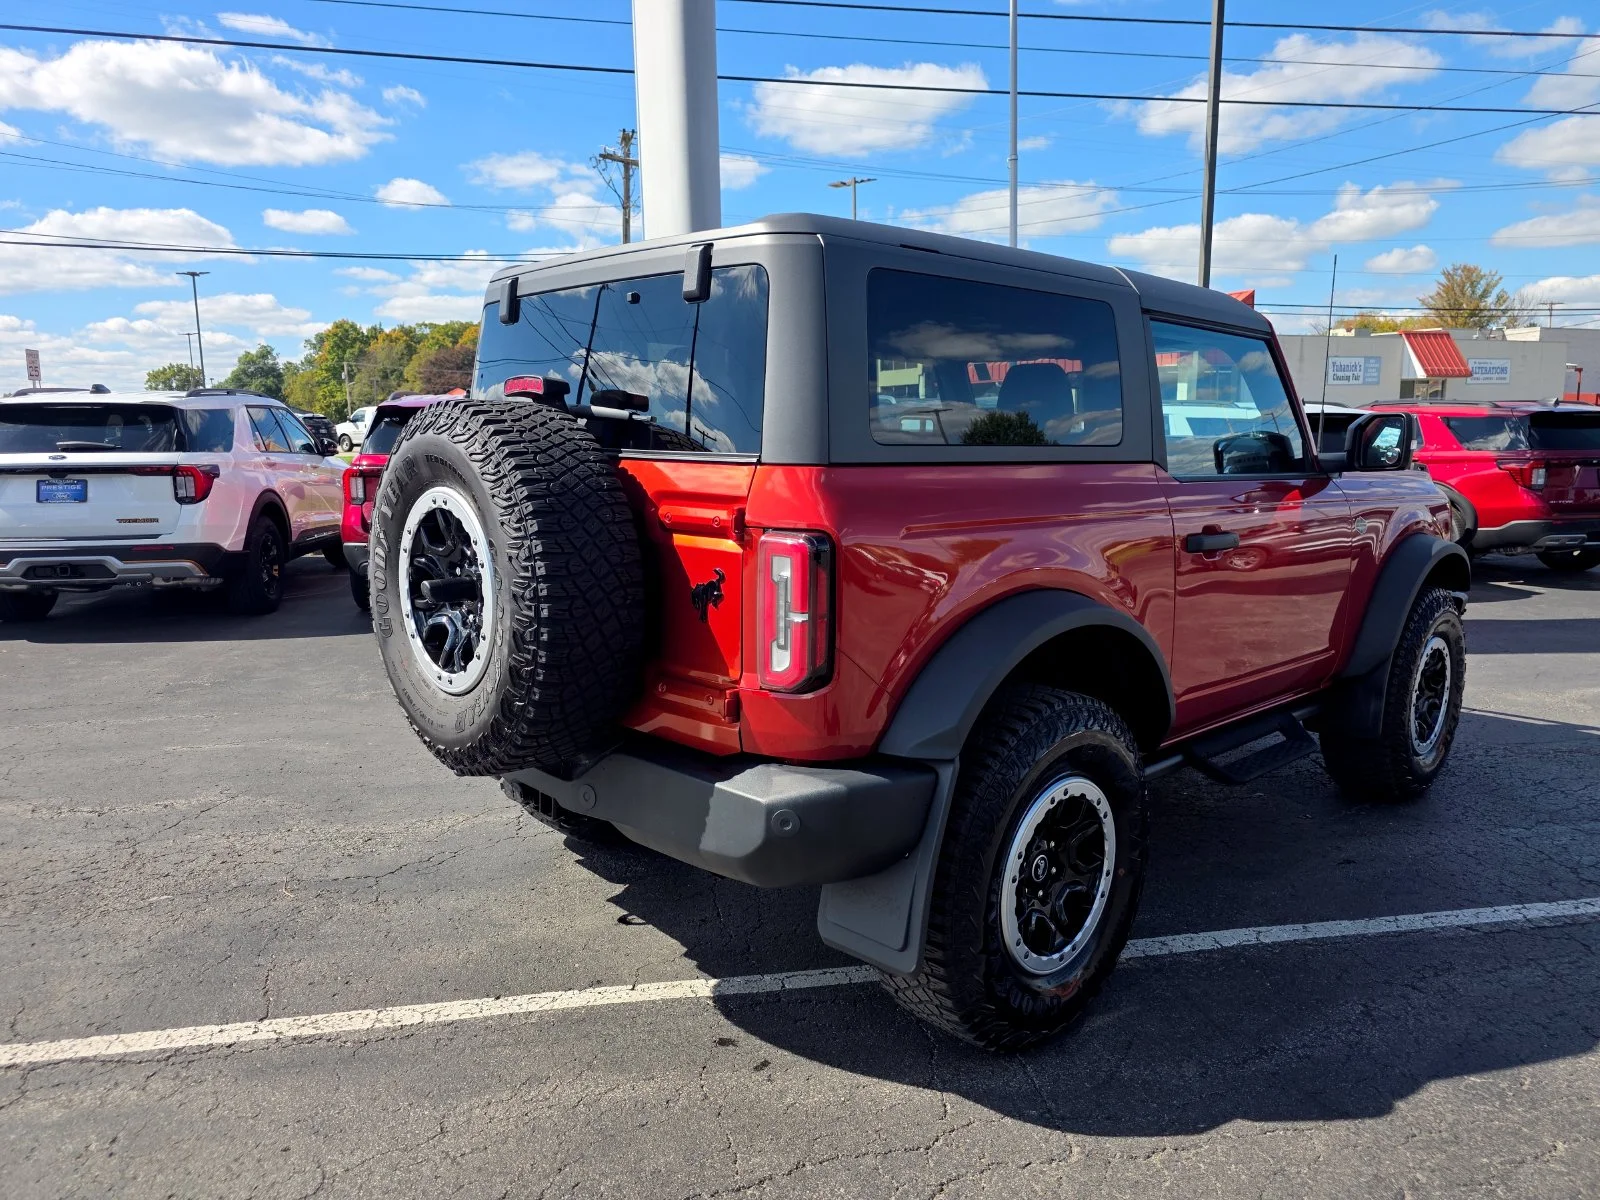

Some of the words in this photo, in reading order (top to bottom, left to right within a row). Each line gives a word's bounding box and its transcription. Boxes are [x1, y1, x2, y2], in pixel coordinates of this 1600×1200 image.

[29, 365, 39, 378] 25
[1332, 361, 1362, 373] Yuhanick's
[1471, 366, 1508, 375] ALTERATIONS
[1332, 373, 1351, 382] Cleaning
[1351, 373, 1361, 381] Fair
